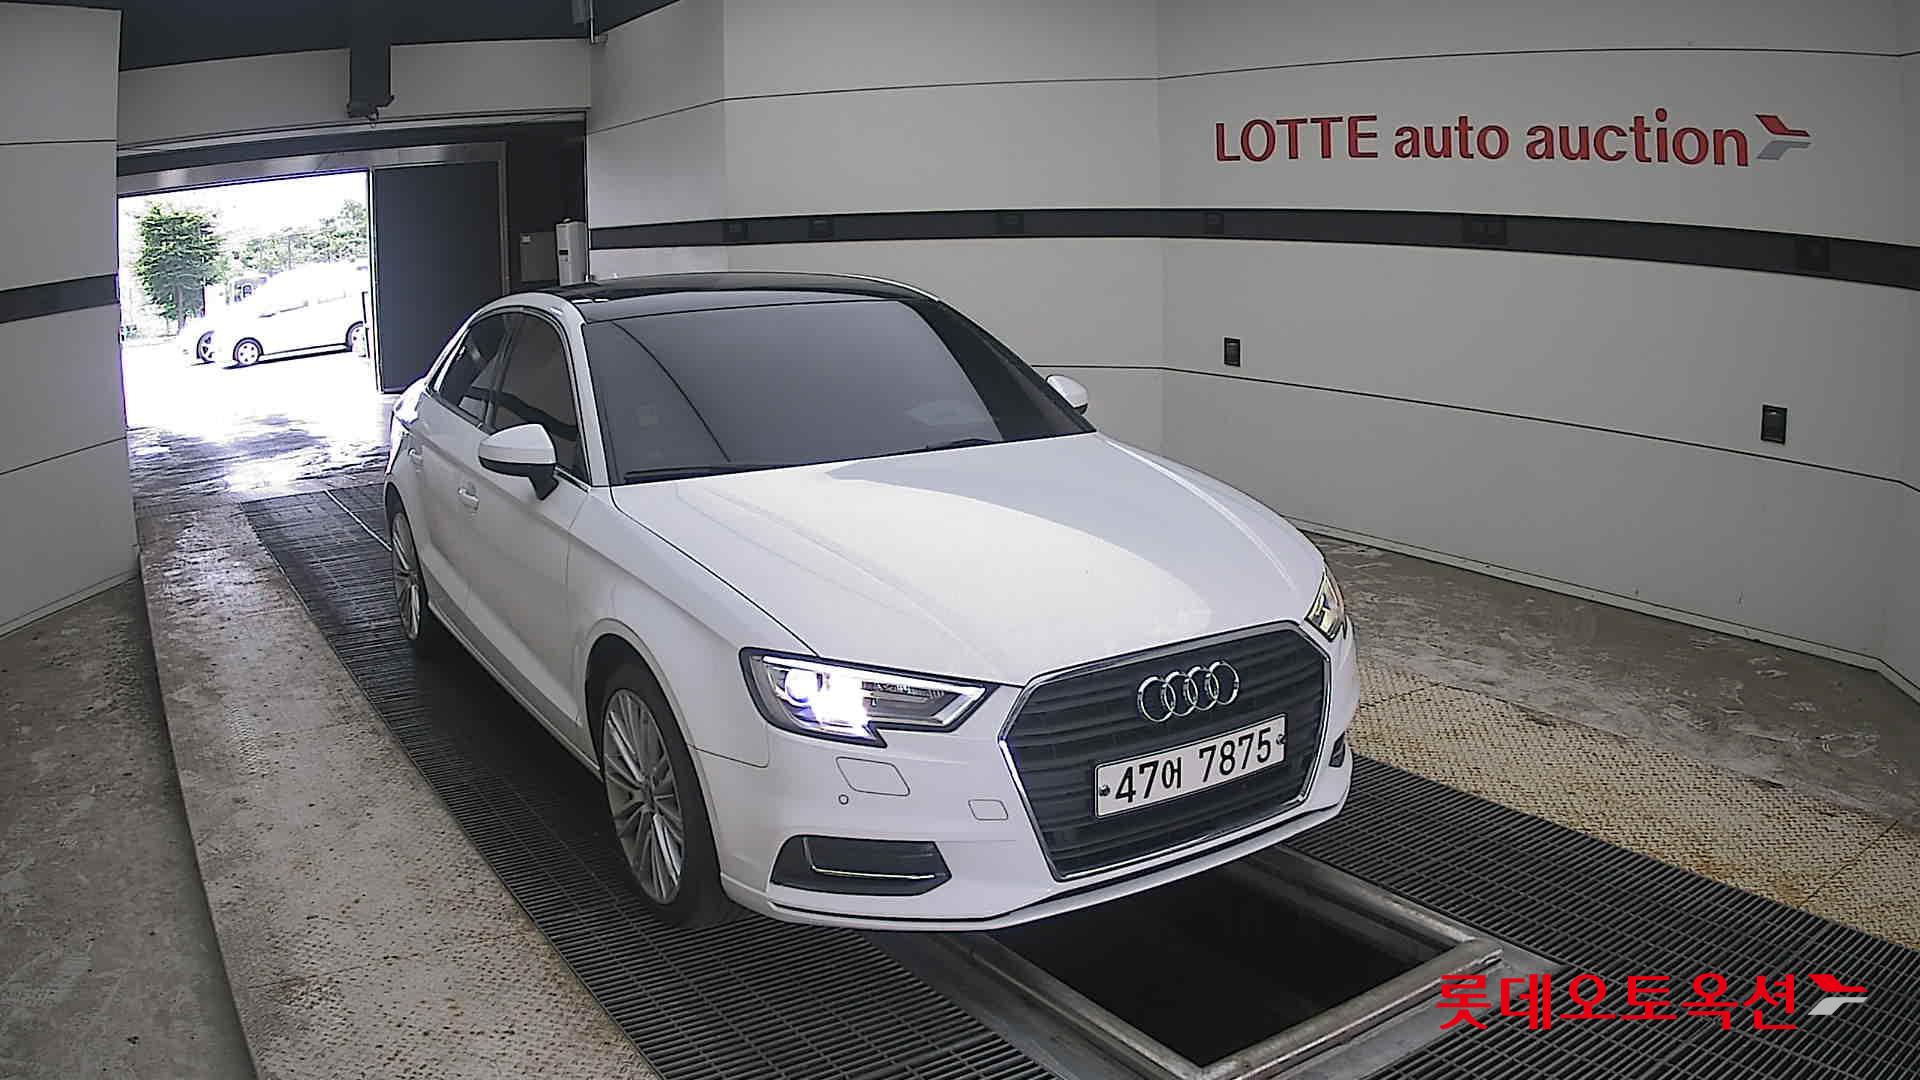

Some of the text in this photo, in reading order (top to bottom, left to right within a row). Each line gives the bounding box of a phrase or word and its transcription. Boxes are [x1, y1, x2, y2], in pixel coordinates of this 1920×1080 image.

[1215, 108, 1749, 167] LOTTE auto auction
[1115, 727, 1272, 803] 47어 7875
